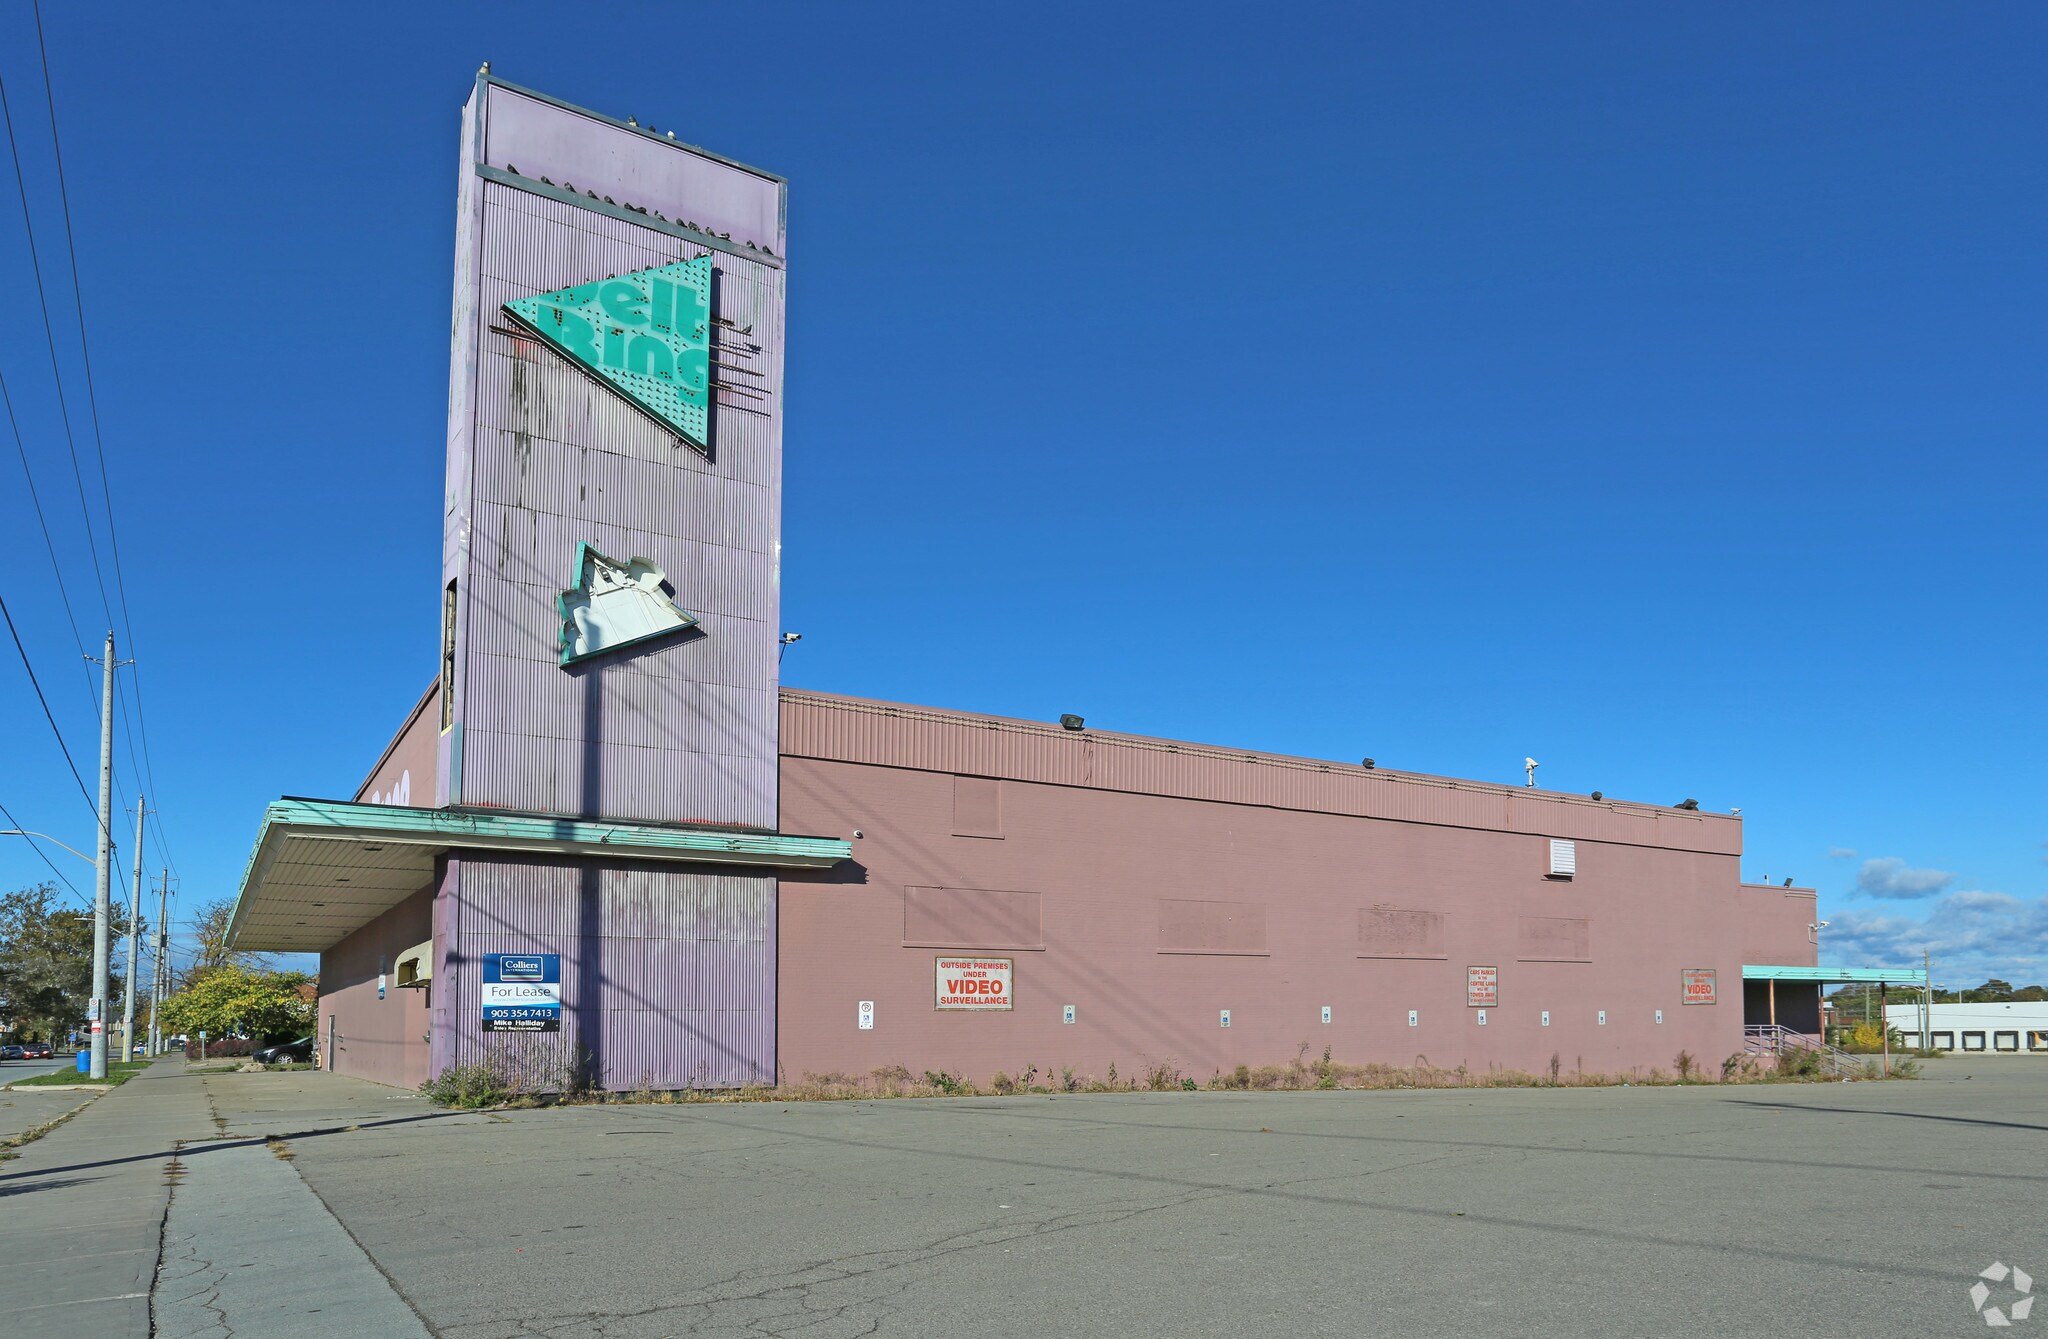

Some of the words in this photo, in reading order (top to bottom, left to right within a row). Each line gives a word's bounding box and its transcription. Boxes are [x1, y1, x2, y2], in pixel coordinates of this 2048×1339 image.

[505, 961, 538, 969] Colliers
[973, 962, 1009, 970] PREMISES
[491, 986, 512, 997] For
[516, 986, 551, 997] Lease
[947, 980, 1003, 995] VIDEO
[1687, 984, 1712, 994] VIDEO
[941, 996, 1008, 1004] SURVEILLANCE
[491, 1010, 508, 1018] 905
